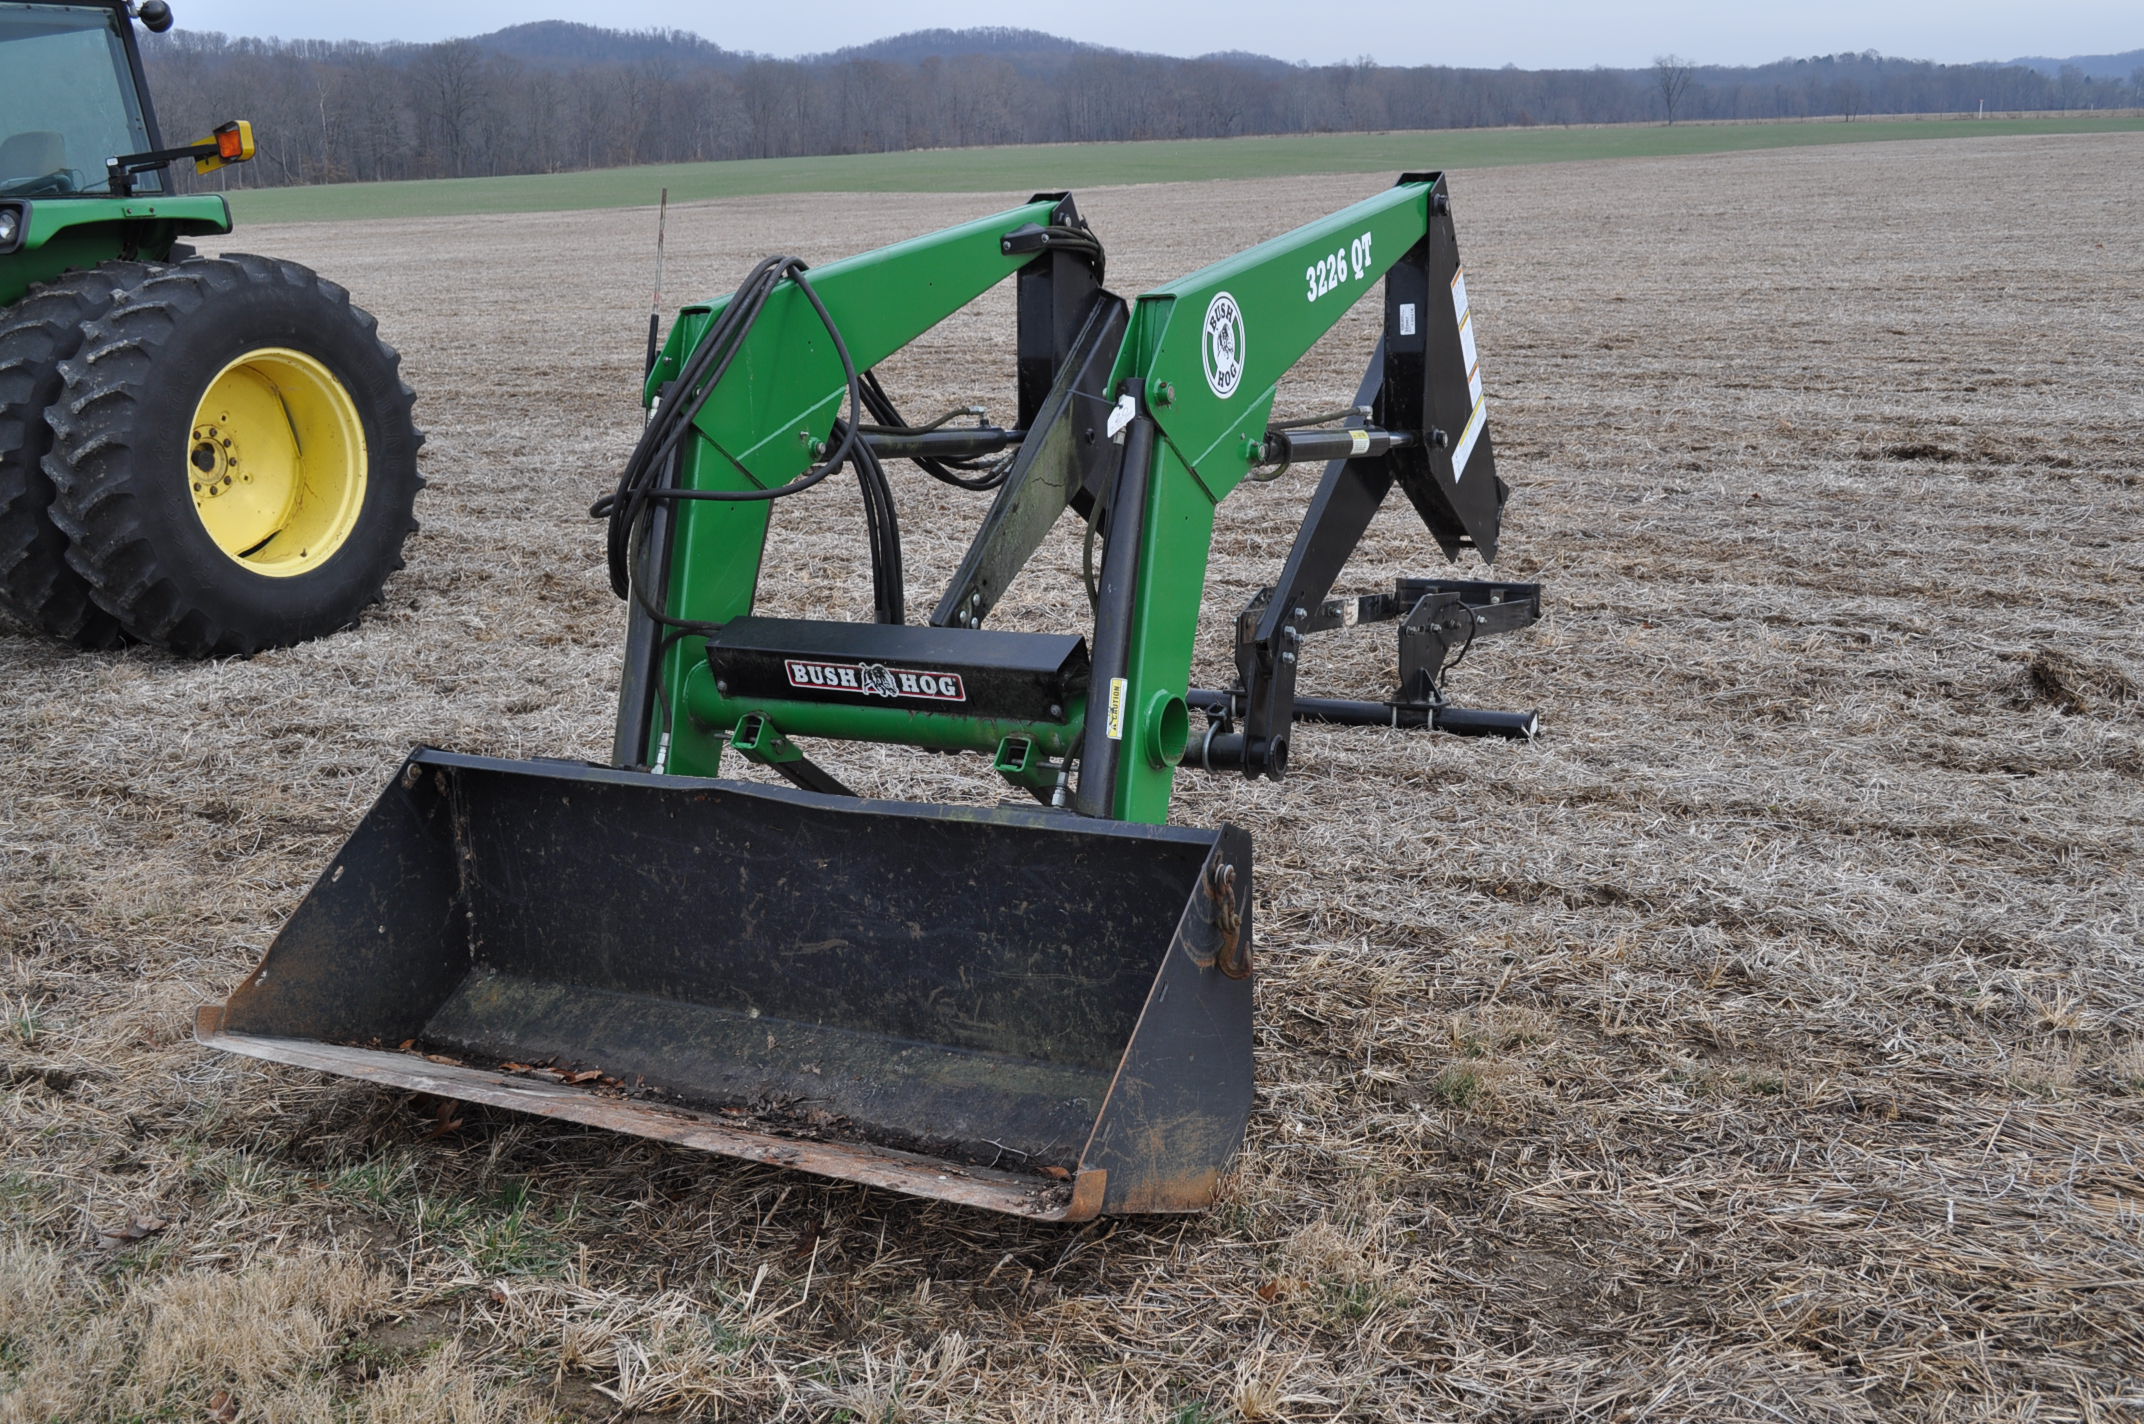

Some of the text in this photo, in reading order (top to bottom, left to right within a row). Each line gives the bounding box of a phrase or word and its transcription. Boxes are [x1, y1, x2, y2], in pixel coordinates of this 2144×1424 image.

[1306, 232, 1372, 303] 3226 QT
[1209, 305, 1234, 331] BUSH
[1217, 363, 1237, 388] HOG
[791, 664, 956, 696] BUSH HOG
